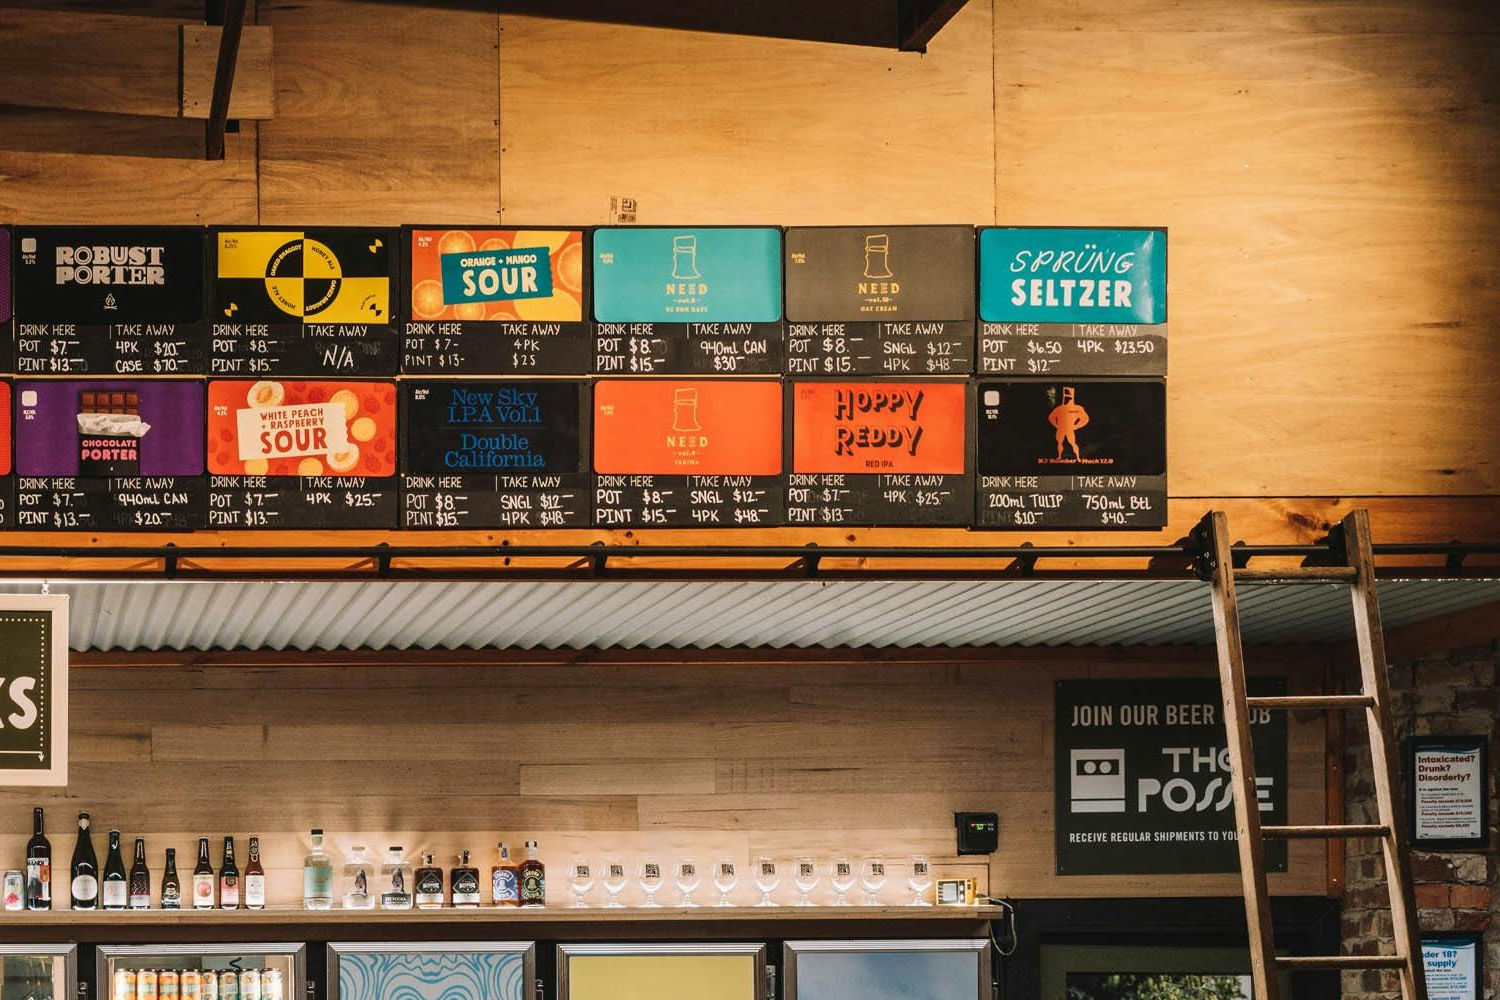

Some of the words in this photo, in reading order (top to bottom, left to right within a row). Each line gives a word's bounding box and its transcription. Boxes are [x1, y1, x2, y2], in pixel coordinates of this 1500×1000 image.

[56, 246, 164, 265] ROBUST
[460, 257, 496, 268] ORANGE
[506, 255, 537, 265] MANGO
[1010, 244, 1135, 273] SPRÜNG
[56, 266, 164, 285] PORTER
[462, 267, 538, 297] SOUR
[858, 283, 899, 295] NEED
[1011, 279, 1133, 308] SELTZER
[1077, 341, 1104, 352] 4PK
[1115, 339, 1154, 353] $23.50
[323, 345, 354, 369] N/A
[212, 359, 244, 371] PINT
[452, 389, 493, 406] New
[499, 388, 538, 408] Sky
[835, 389, 924, 421] HOPPY
[261, 411, 287, 420] WHITE
[292, 408, 323, 418] PEACH
[271, 418, 324, 429] RASPBERRY
[260, 428, 328, 454] SOUR
[462, 434, 529, 450] Double
[668, 436, 708, 448] NEED
[835, 425, 923, 456] REDDY
[82, 449, 137, 460] PORTER
[444, 451, 546, 468] California
[502, 496, 532, 509] SNGL
[989, 494, 1026, 508] 200ml
[1029, 494, 1063, 507] TULIP
[1071, 706, 1112, 726] JOIN
[1120, 705, 1158, 726] OUR
[1166, 705, 1214, 725] BEER
[1418, 755, 1475, 763] Intoxicated?
[1419, 774, 1470, 782] Disorderly?
[1070, 833, 1107, 842] RECEIVE
[1111, 832, 1150, 842] REGULAR
[1154, 832, 1204, 841] SHIPMENTS
[1208, 832, 1218, 841] TO
